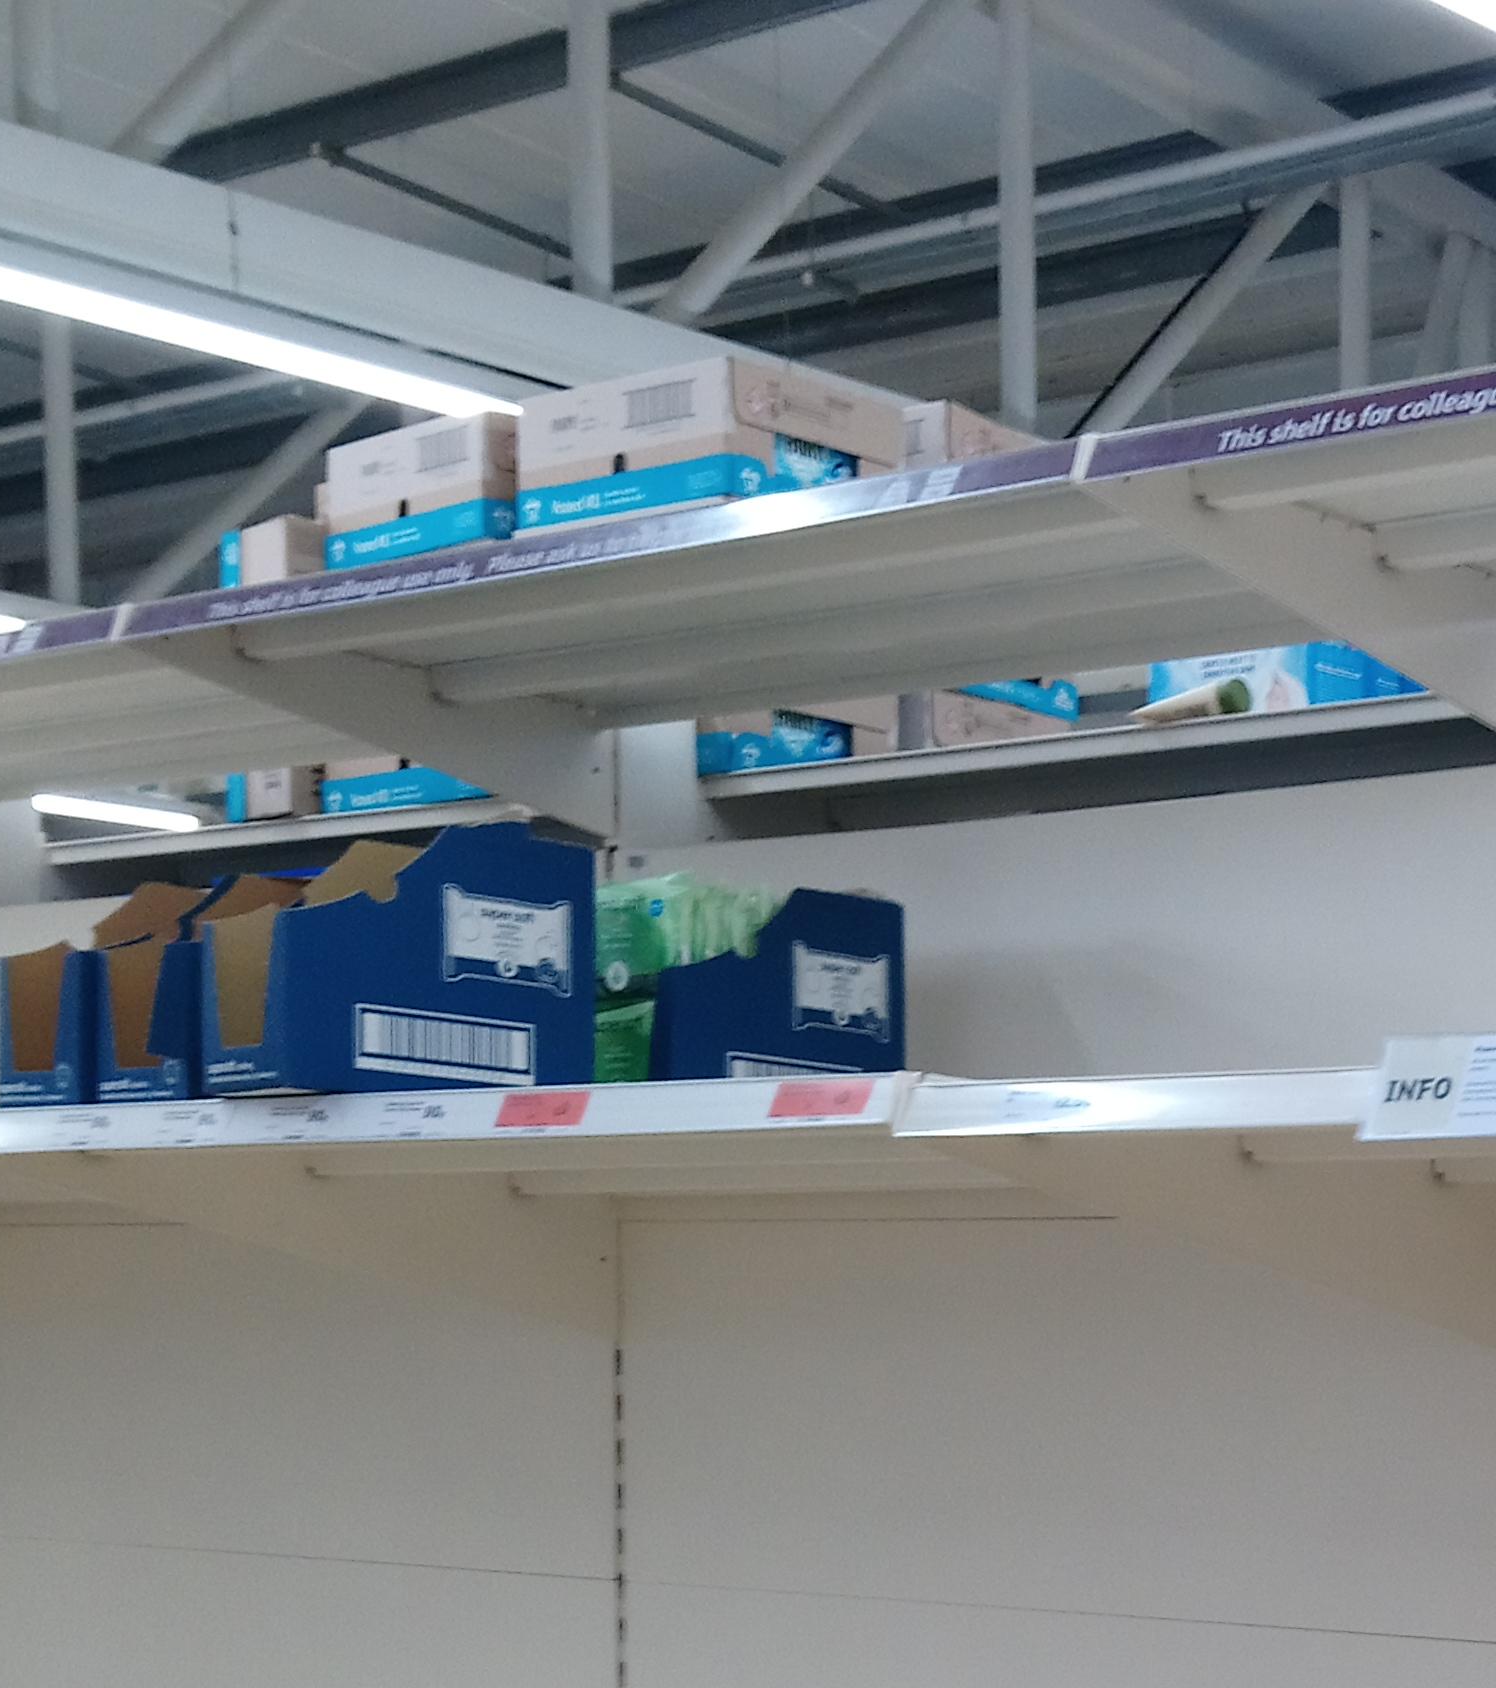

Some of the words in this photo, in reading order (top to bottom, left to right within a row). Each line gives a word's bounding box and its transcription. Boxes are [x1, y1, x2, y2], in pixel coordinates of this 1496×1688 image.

[1216, 427, 1267, 454] This
[1269, 407, 1333, 444] shelf
[1332, 408, 1357, 433] is
[1357, 402, 1398, 431] for
[1384, 1075, 1453, 1103] INFO
